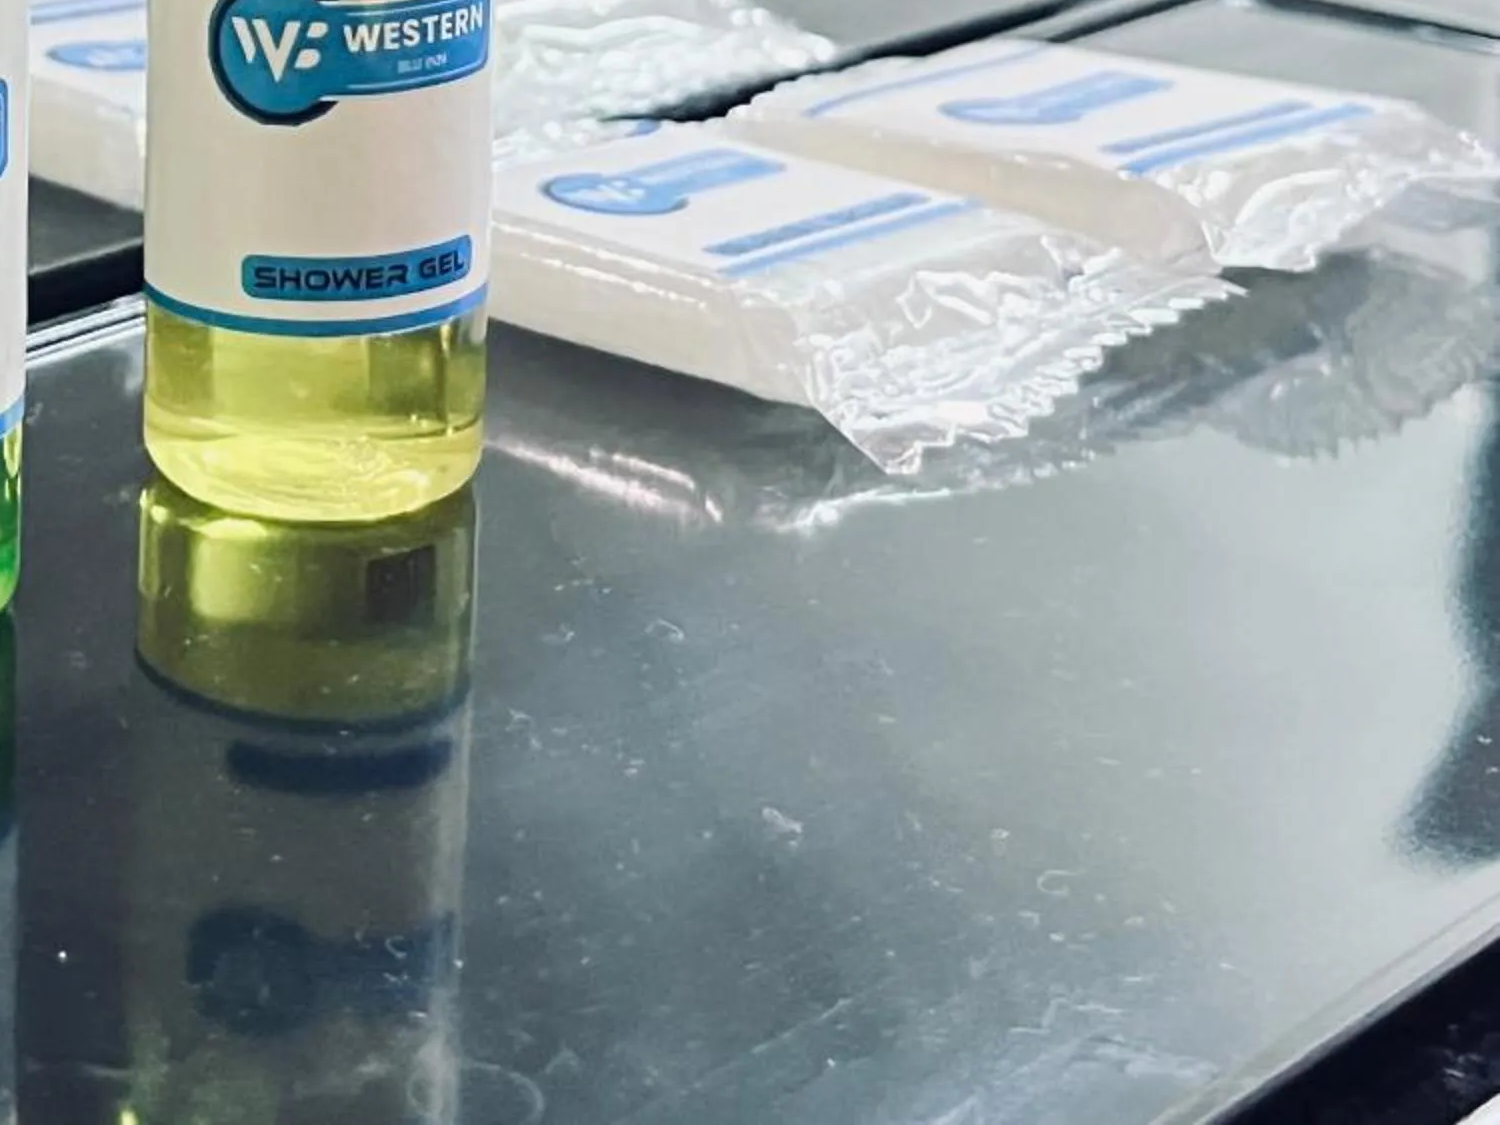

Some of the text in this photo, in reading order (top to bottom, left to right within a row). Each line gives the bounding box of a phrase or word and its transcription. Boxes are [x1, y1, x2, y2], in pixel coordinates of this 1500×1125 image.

[343, 1, 484, 54] WESTERN
[253, 250, 466, 292] SHOWER GEL
